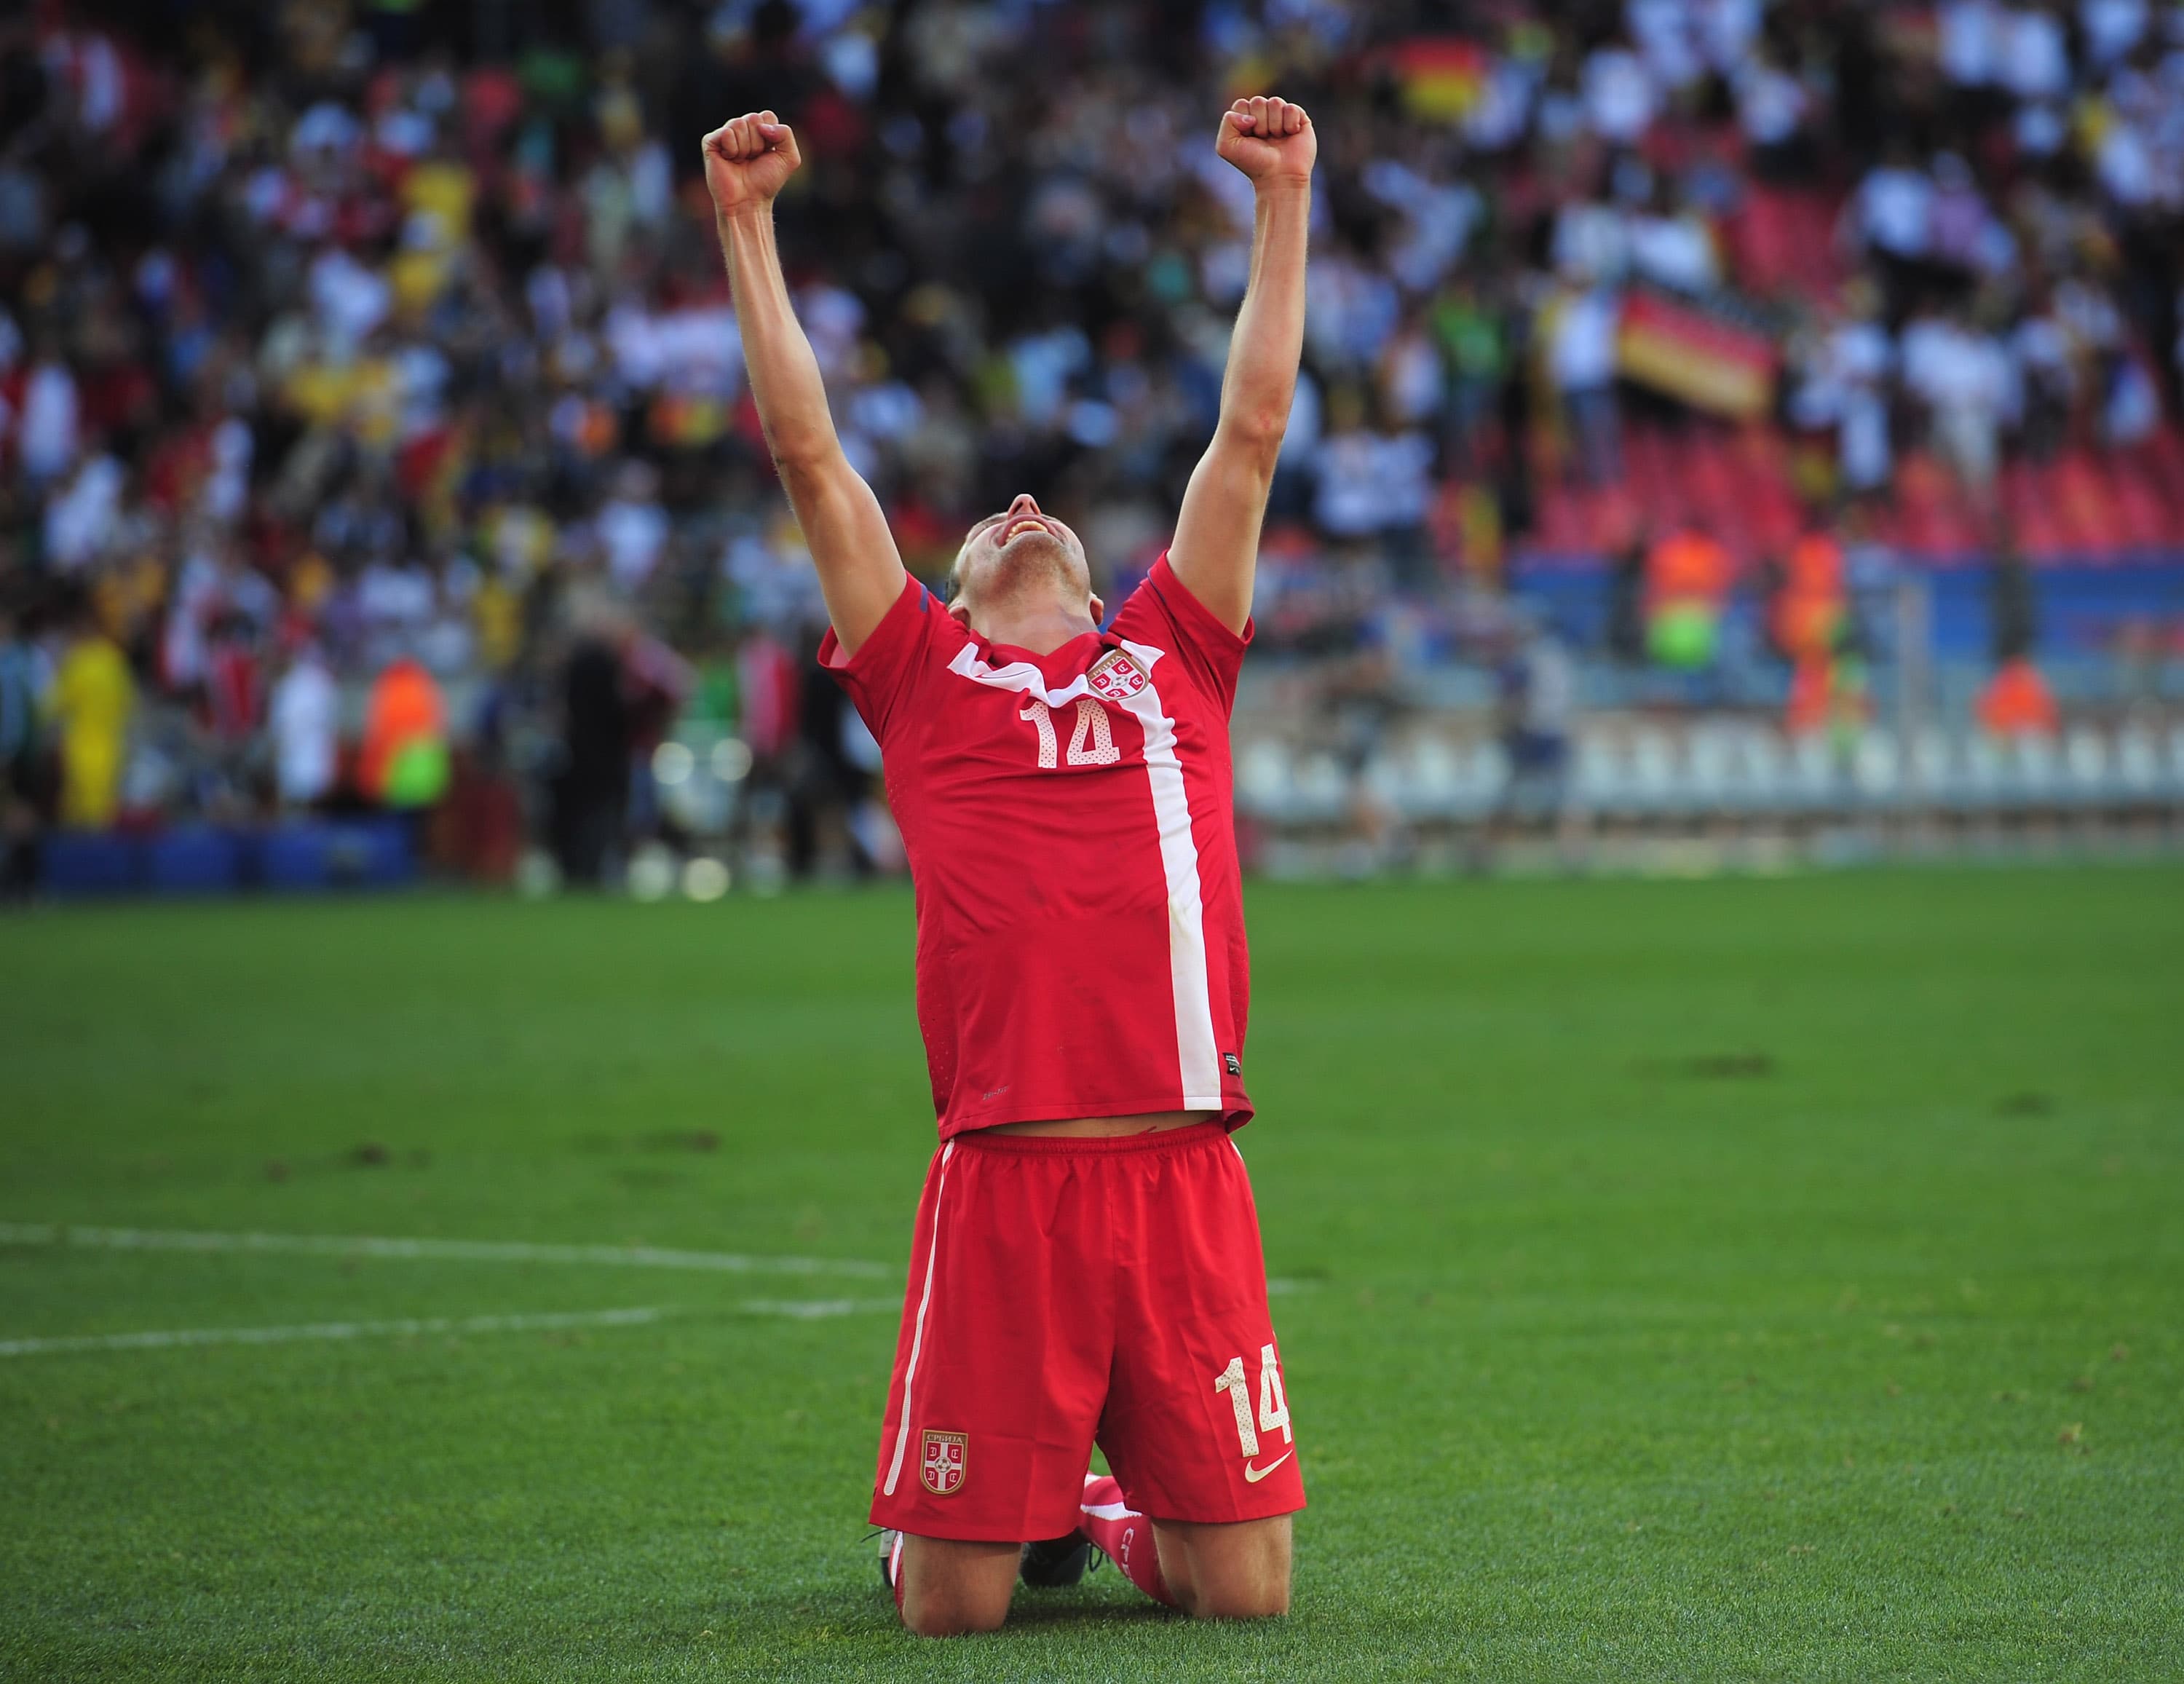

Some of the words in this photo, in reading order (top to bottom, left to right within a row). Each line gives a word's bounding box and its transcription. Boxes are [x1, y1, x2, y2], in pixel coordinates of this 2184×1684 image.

[1019, 697, 1120, 769] 14
[1215, 1343, 1292, 1458] 14
[927, 1434, 962, 1444] СРБИЈА
